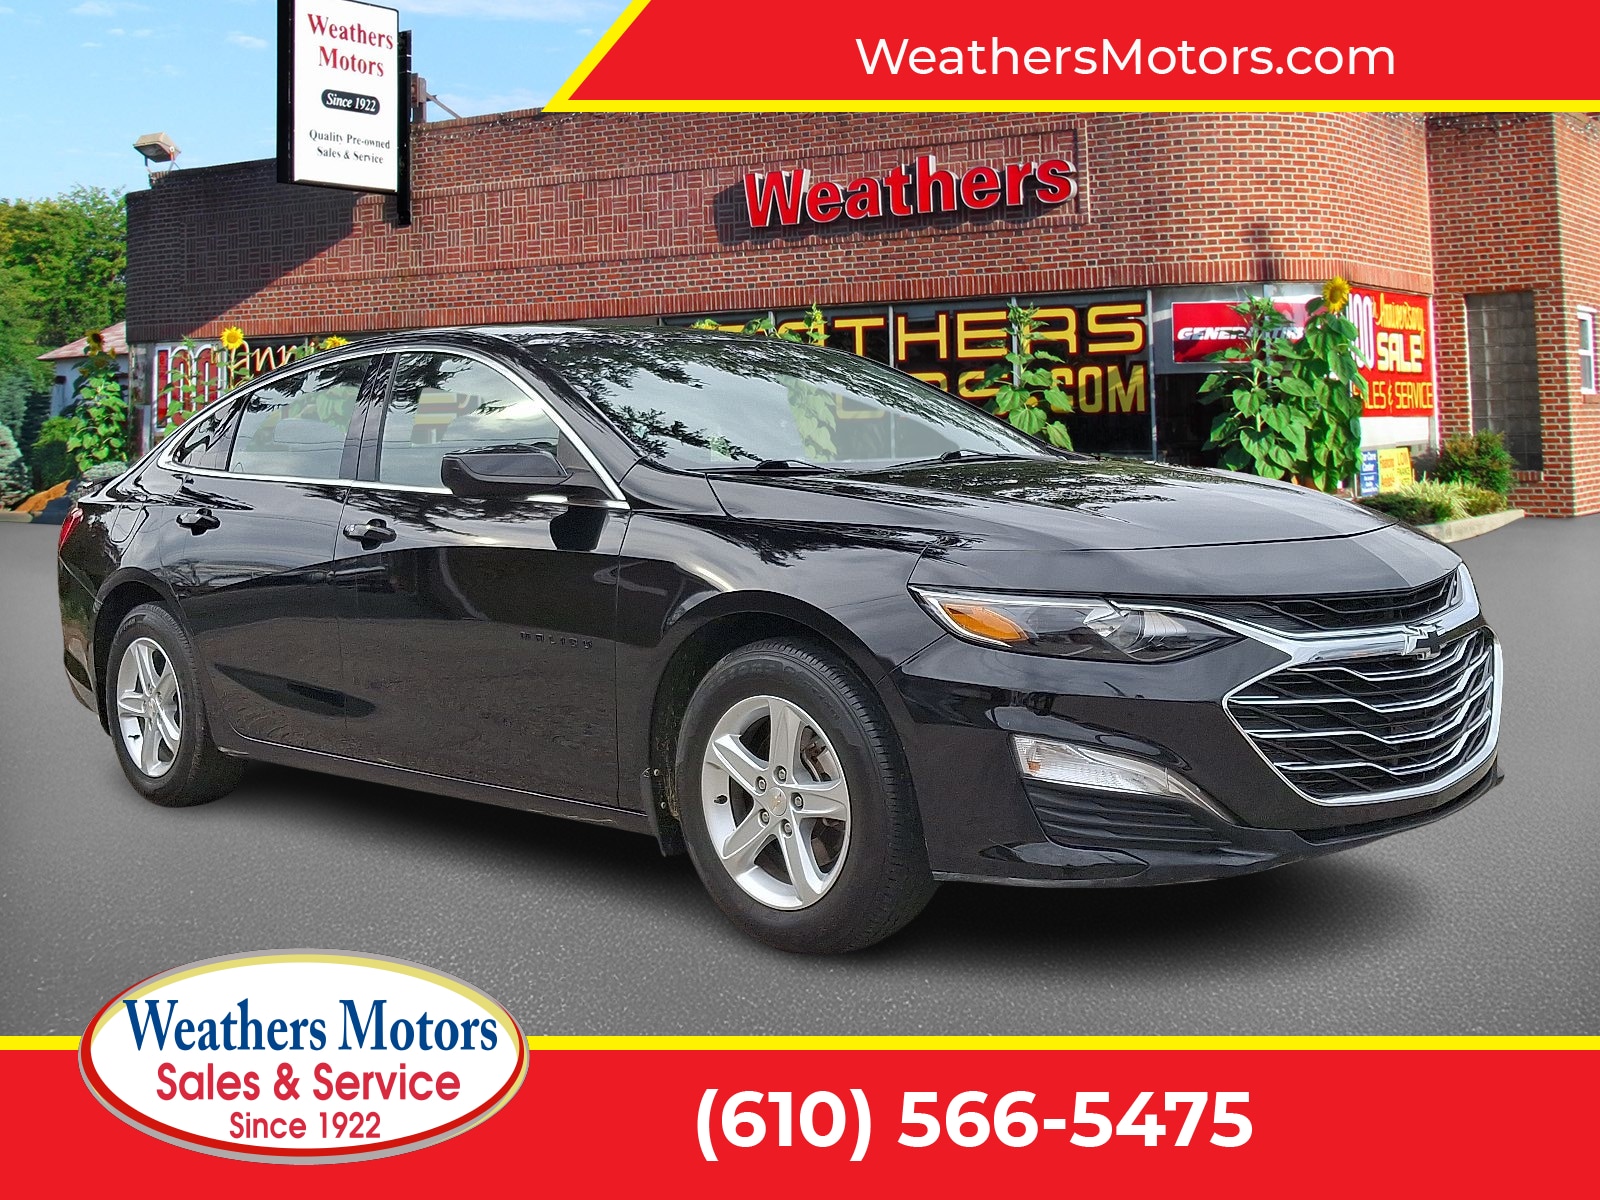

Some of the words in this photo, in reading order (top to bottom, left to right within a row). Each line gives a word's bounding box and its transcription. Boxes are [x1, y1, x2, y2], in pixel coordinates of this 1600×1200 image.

[307, 13, 394, 50] Weathers
[318, 46, 385, 77] Motors
[326, 92, 353, 108] Since
[355, 97, 377, 112] 1922
[309, 129, 343, 145] Quality
[346, 133, 390, 150] Pre-owned
[317, 146, 341, 159] Sales
[343, 149, 350, 160] &
[353, 151, 384, 164] Service
[743, 155, 1077, 229] Weathers
[1376, 332, 1423, 373] SALE
[1394, 381, 1434, 409] SERVICE
